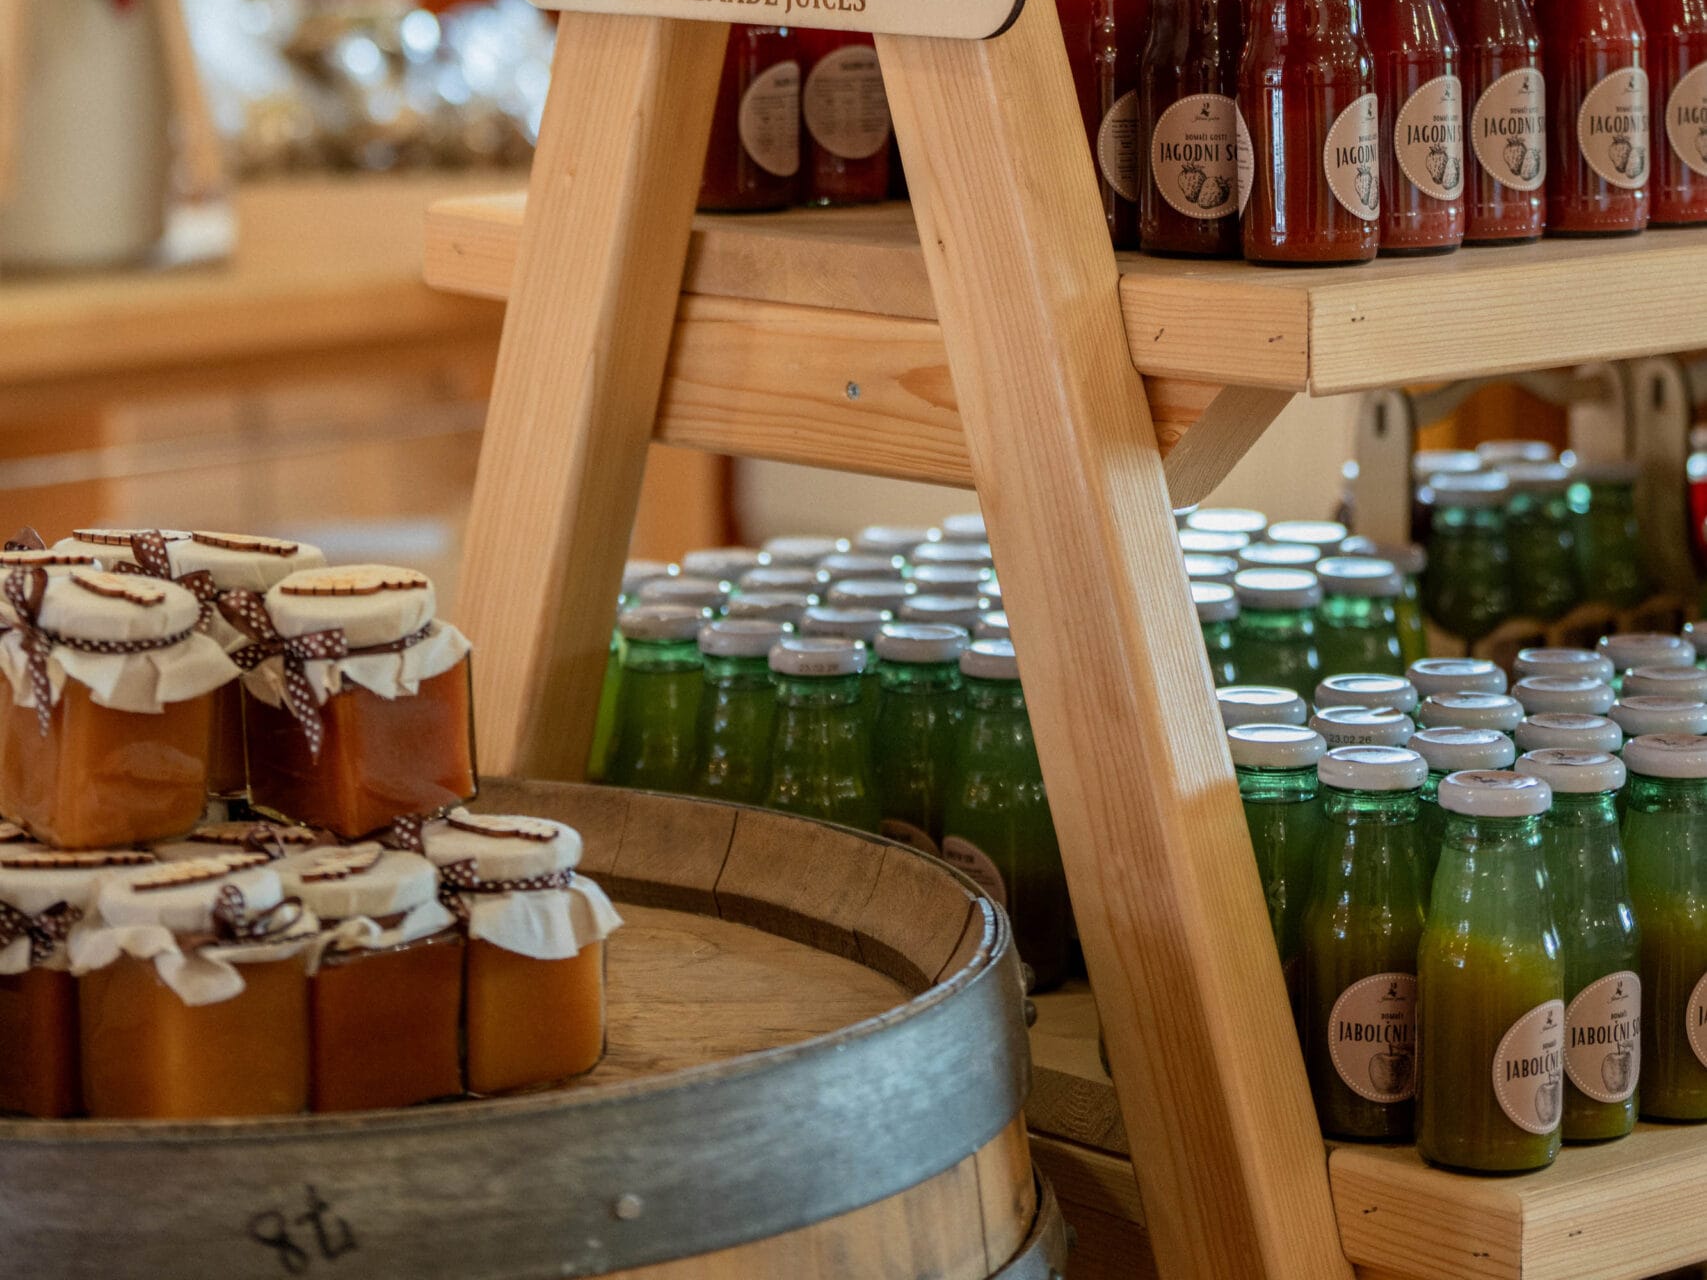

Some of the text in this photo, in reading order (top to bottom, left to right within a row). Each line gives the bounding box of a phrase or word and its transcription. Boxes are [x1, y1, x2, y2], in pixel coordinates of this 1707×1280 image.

[1407, 124, 1456, 146] JAGODNI
[1484, 116, 1535, 139] JAGODNI
[1160, 142, 1219, 163] JAGODNI
[1339, 1020, 1408, 1044] JABOLČNI
[1571, 1020, 1630, 1049] JABOLČNI
[1506, 1049, 1559, 1083] JABOLČNI
